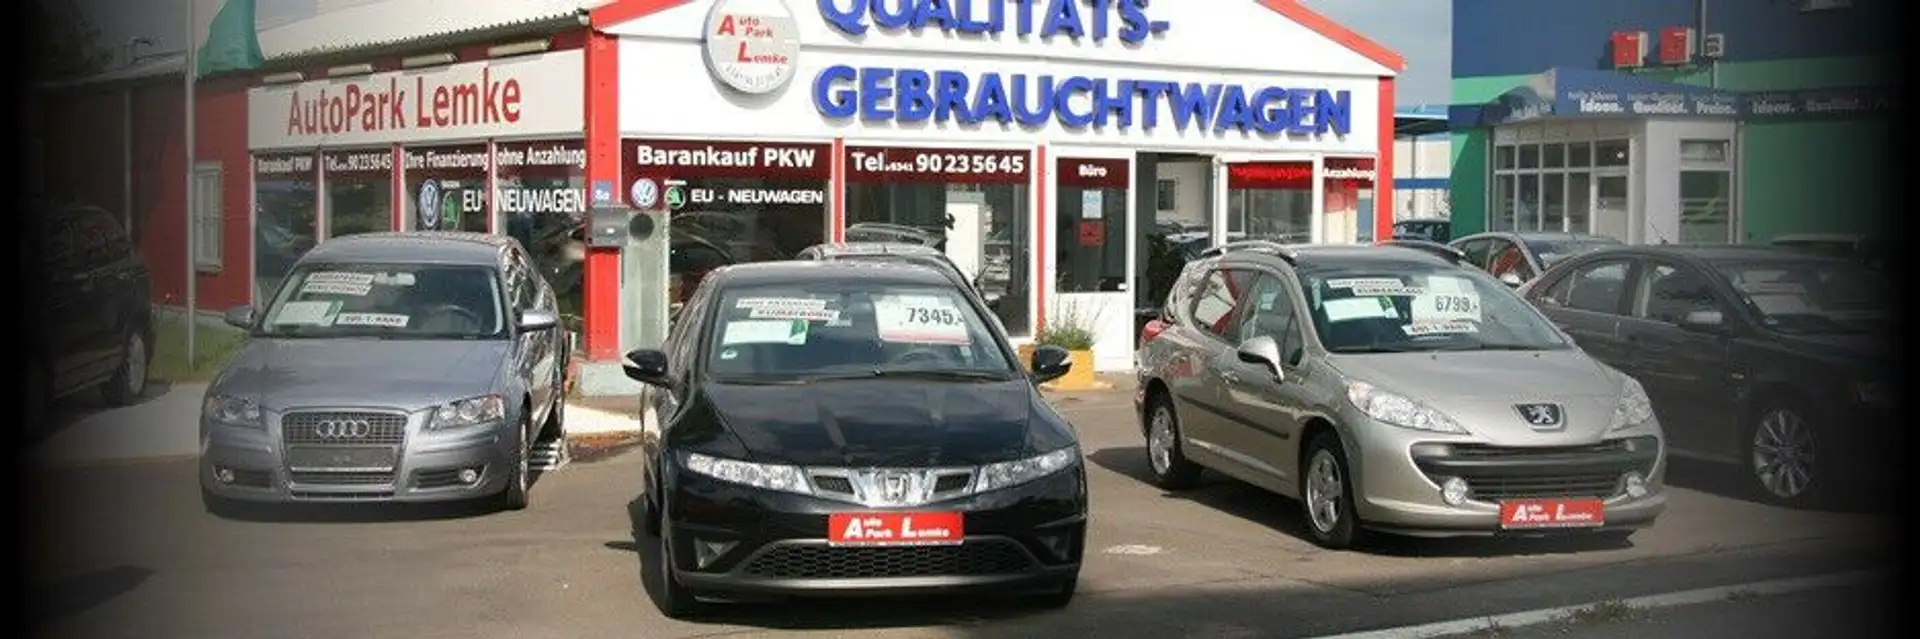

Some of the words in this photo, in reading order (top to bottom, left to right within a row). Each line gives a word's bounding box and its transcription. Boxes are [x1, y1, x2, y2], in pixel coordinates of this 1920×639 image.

[287, 78, 405, 136] AutoPark
[416, 68, 521, 128] Lemke
[812, 65, 1351, 135] GEBRAUCHTWAGEN
[526, 144, 587, 168] Anzahlung
[637, 145, 757, 166] Barankauf
[764, 148, 815, 167] PKW
[463, 189, 482, 212] EU
[496, 188, 587, 212] NEUWAGEN
[691, 189, 714, 202] EU
[728, 190, 824, 204] NEUWAGEN
